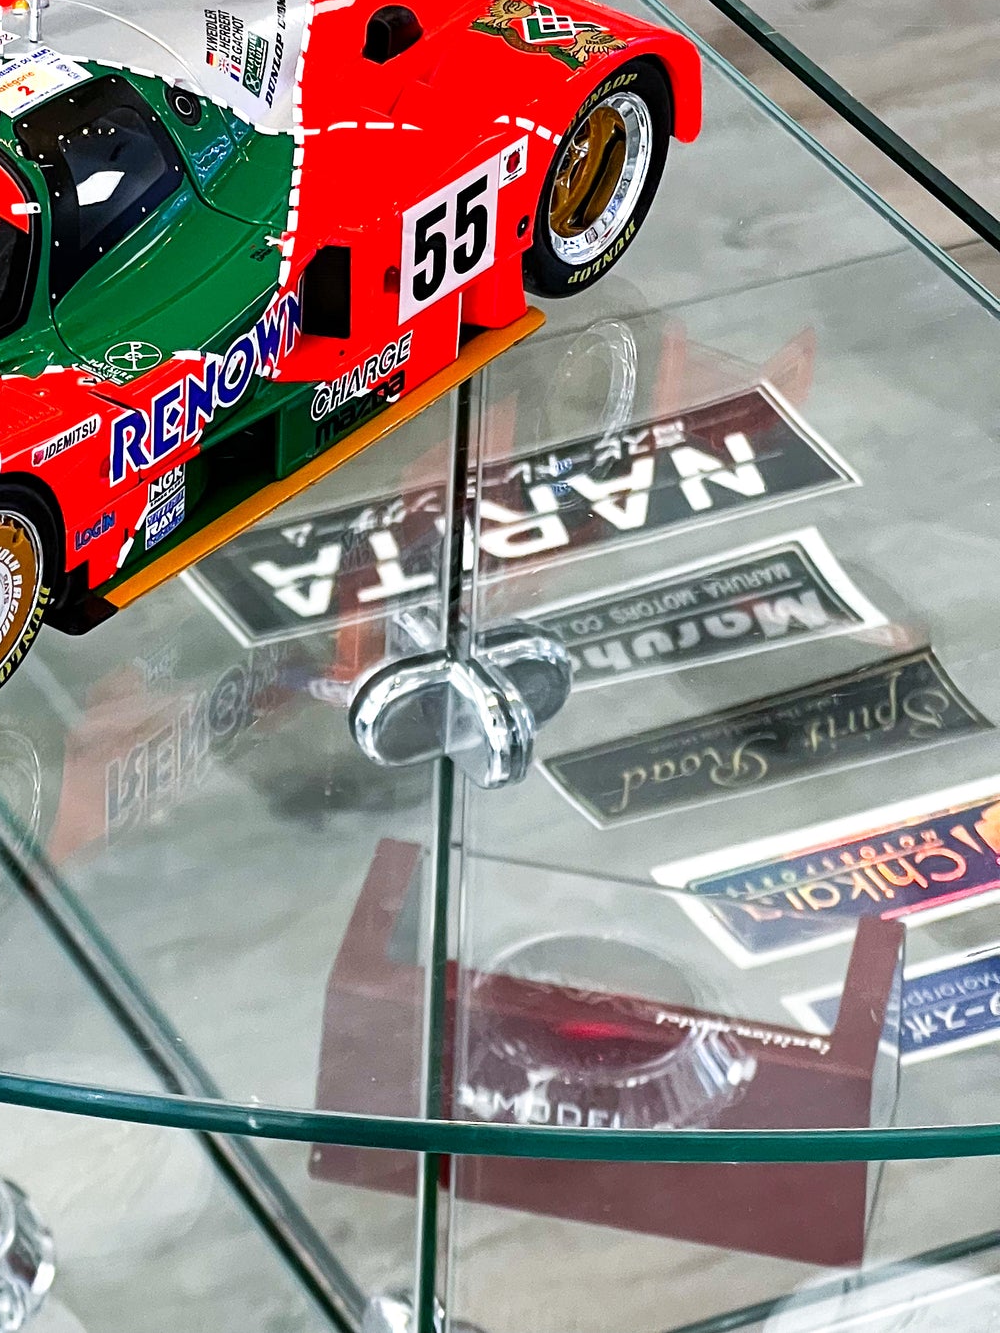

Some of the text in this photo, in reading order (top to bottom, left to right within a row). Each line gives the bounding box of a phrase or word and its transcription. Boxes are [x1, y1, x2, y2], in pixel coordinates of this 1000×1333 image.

[204, 9, 218, 52] V.WEIDLER
[231, 16, 244, 65] B.GACHOT
[18, 85, 35, 97] 2
[265, 32, 284, 109] DUNLOP
[412, 174, 489, 302] 55
[566, 218, 638, 285] DUNLOP
[109, 292, 303, 487] RENOWN
[311, 330, 414, 422] CHARGE
[43, 419, 98, 461] IDEMITSU
[315, 370, 406, 450] mazda
[150, 465, 183, 501] NGK
[146, 502, 185, 542] RAYS
[704, 562, 792, 601] MARUHA
[806, 670, 950, 754] Spirit
[612, 732, 778, 813] Road
